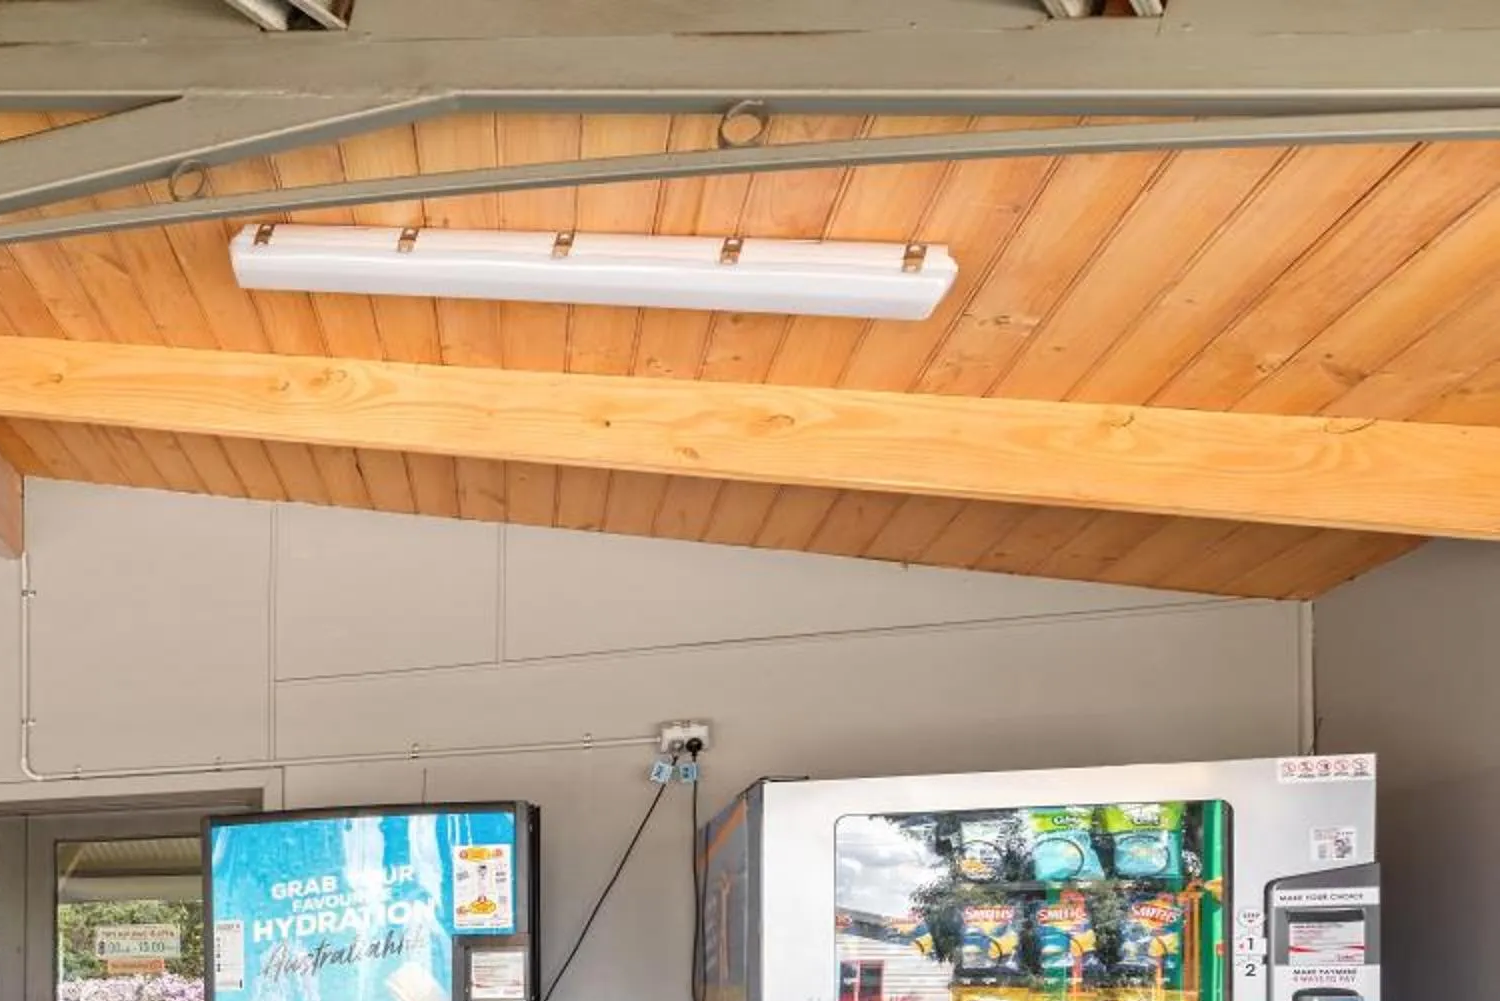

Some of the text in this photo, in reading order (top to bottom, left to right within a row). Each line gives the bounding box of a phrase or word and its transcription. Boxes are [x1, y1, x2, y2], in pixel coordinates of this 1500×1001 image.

[271, 875, 337, 899] GRAB
[253, 897, 436, 943] HYDRATION
[1247, 937, 1254, 950] 1
[1245, 963, 1256, 977] 2
